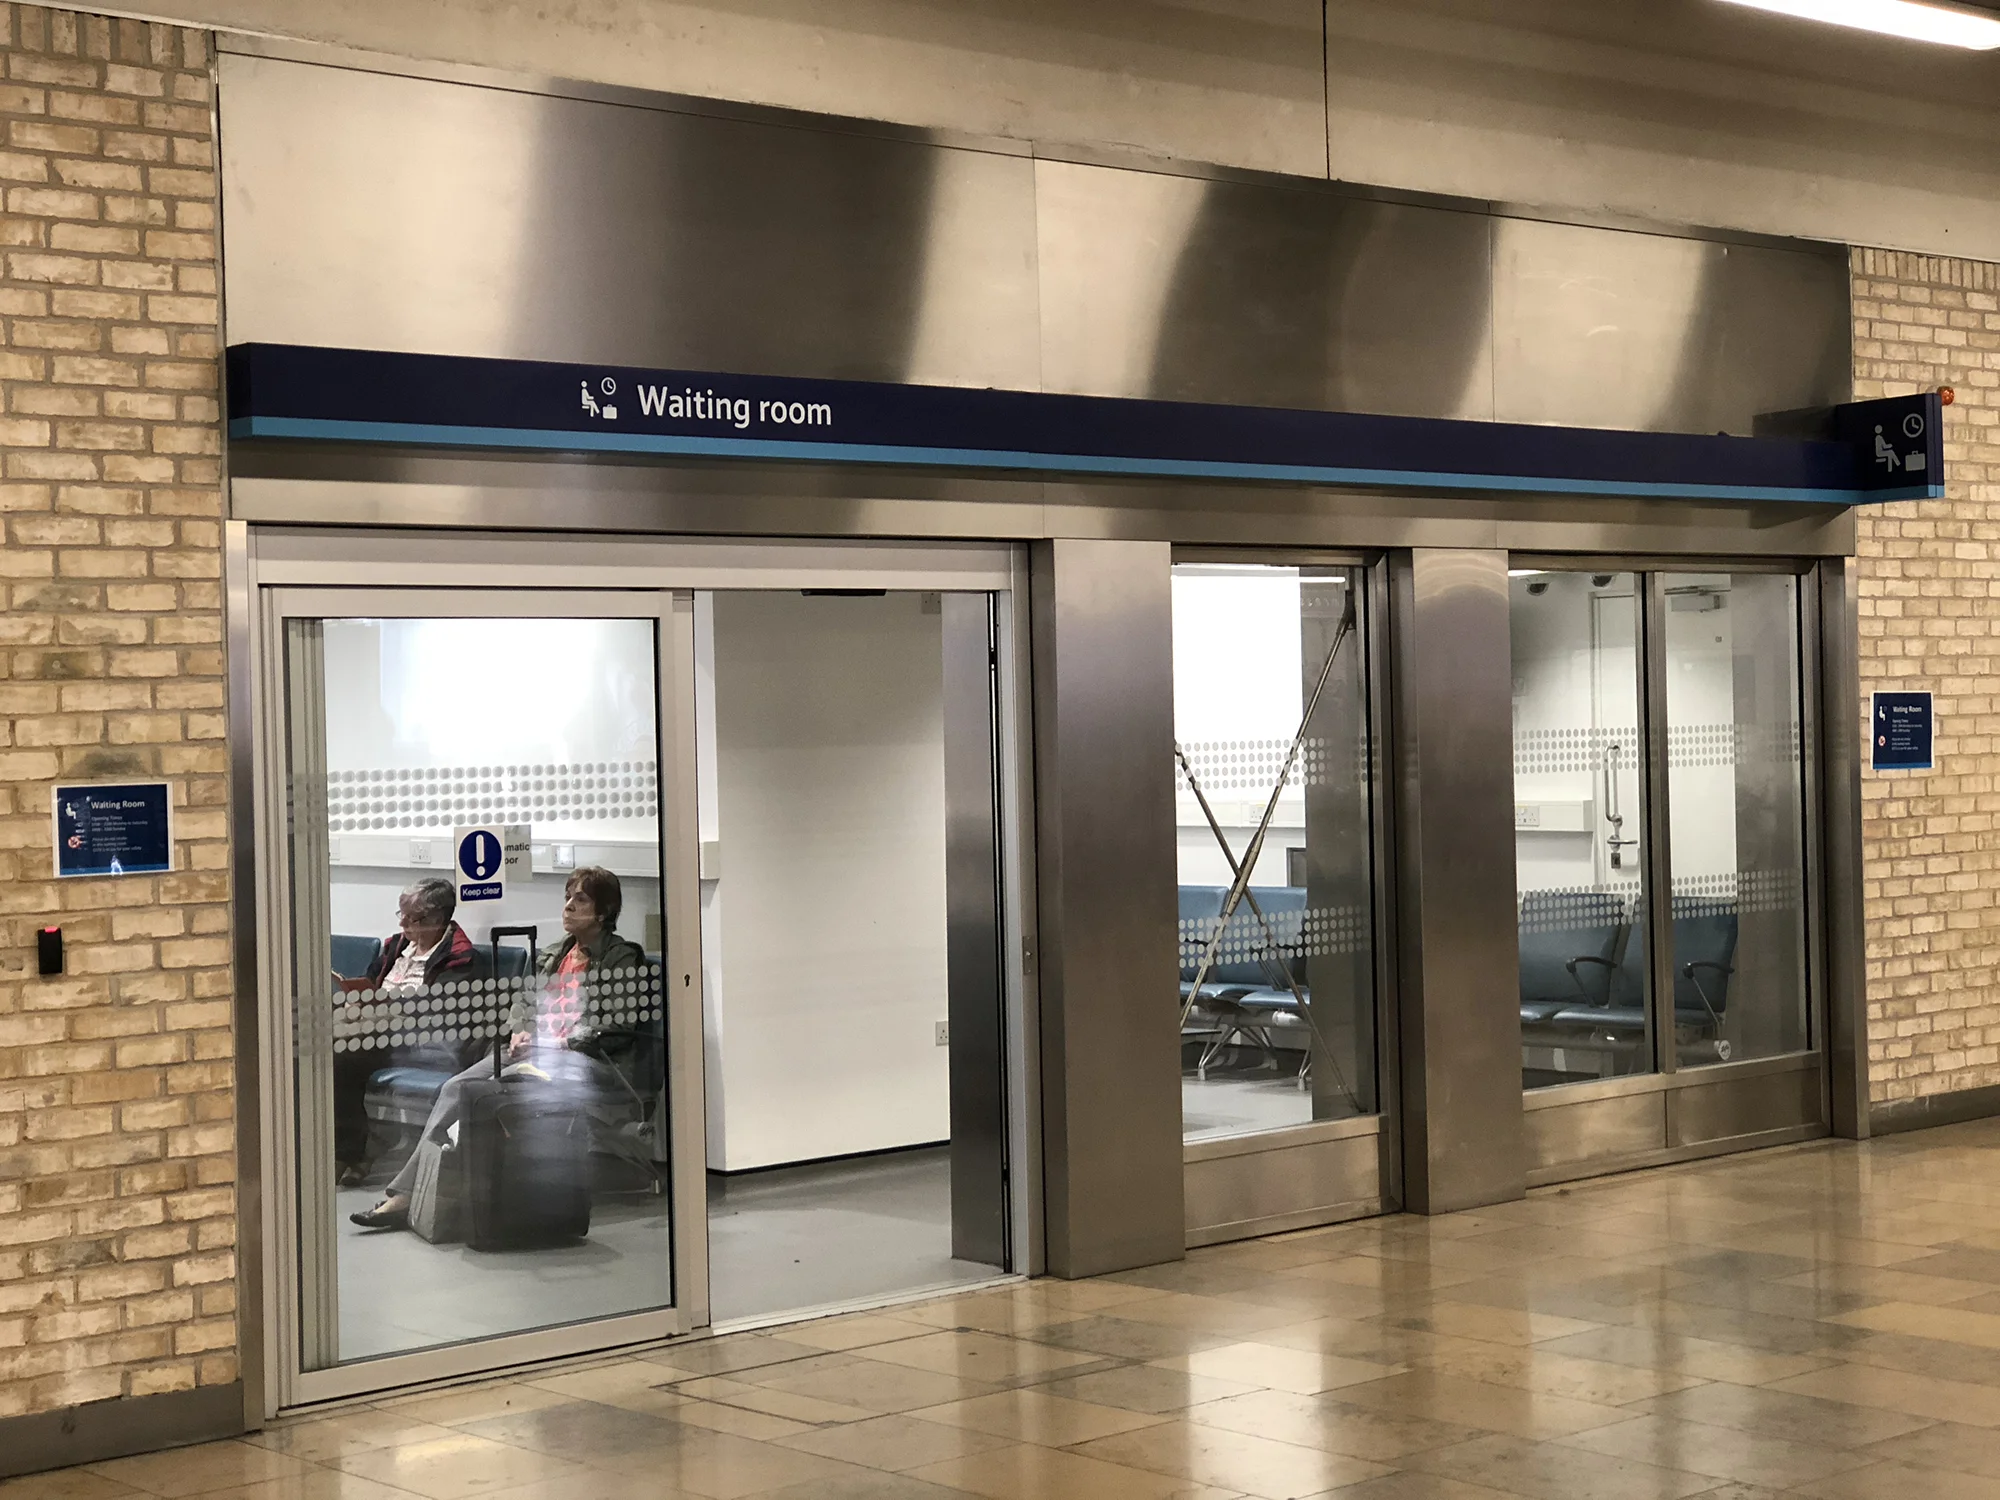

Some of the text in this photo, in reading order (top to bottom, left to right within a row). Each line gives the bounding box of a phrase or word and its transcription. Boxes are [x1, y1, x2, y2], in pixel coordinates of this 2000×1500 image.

[637, 384, 832, 429] Waiting room
[91, 800, 145, 810] Waiting Room
[504, 842, 530, 852] matic
[462, 886, 500, 897] Keep clear
